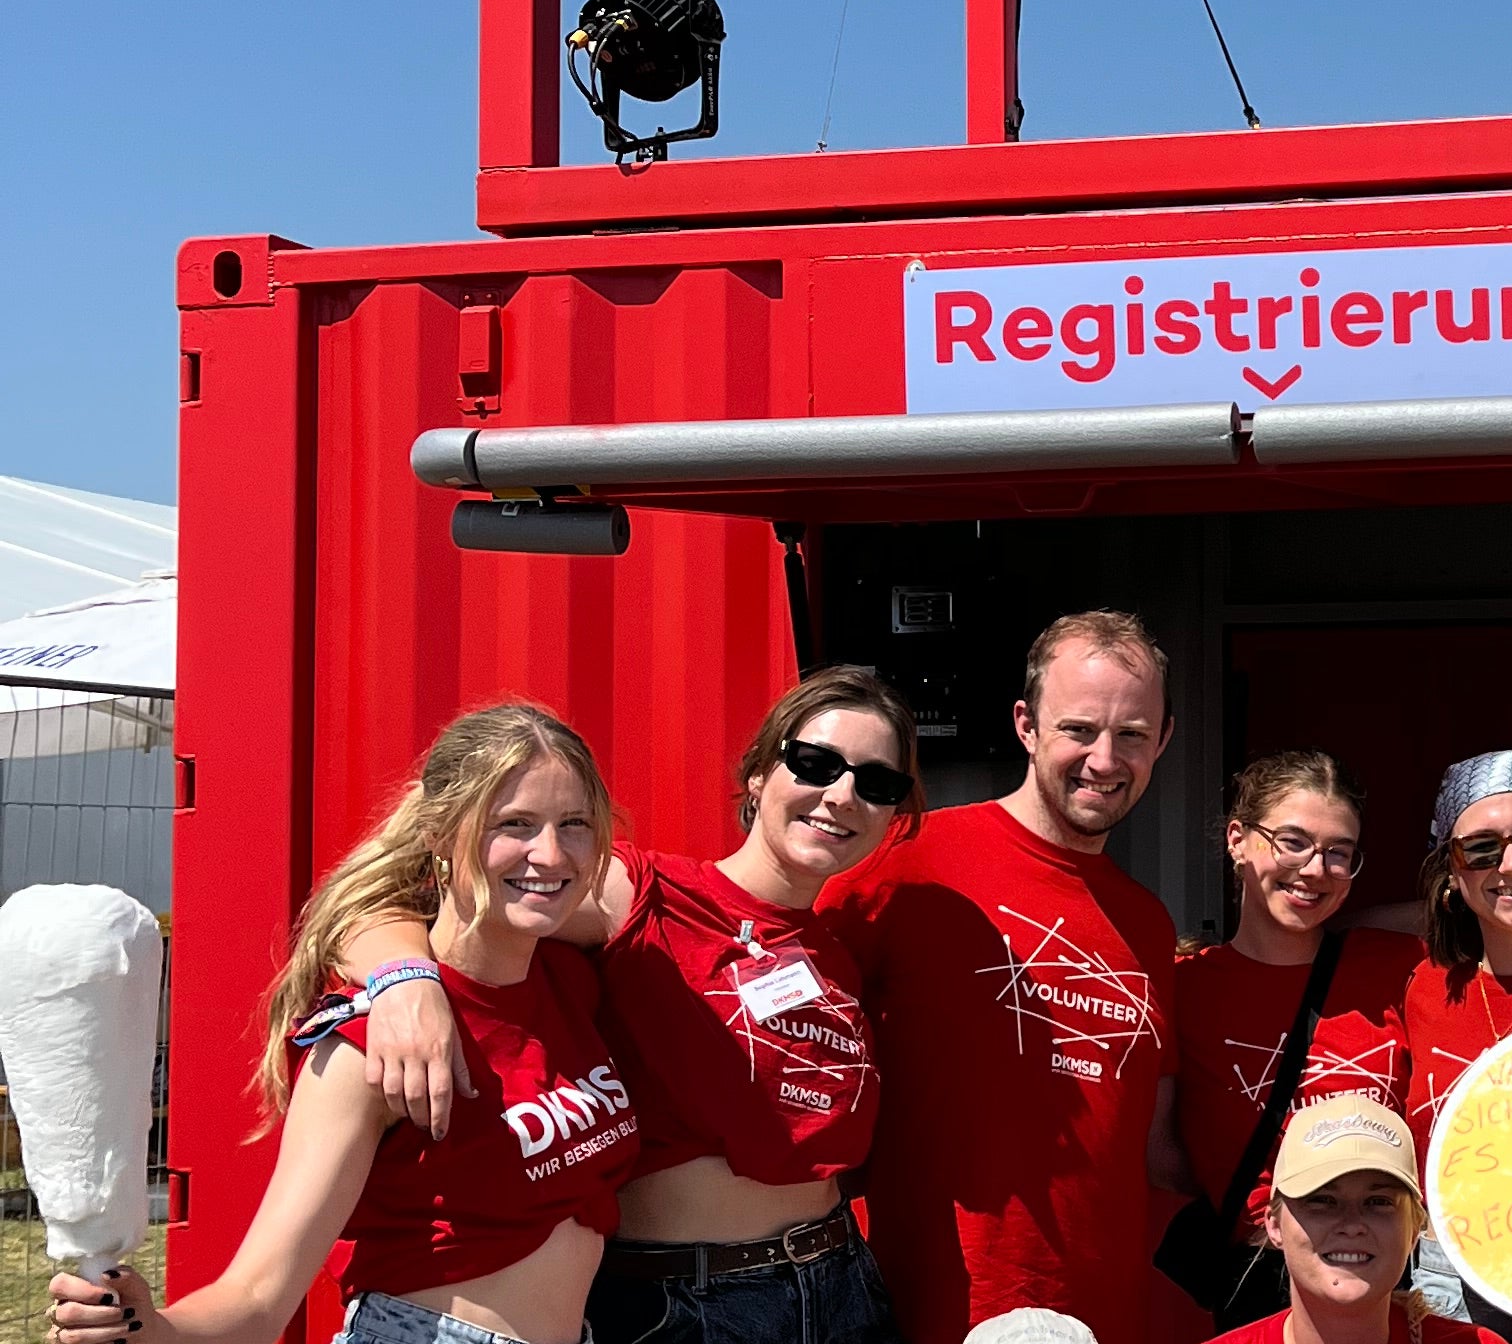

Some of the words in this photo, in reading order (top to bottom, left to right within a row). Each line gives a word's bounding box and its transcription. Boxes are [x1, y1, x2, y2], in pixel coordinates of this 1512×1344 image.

[0, 644, 98, 668] EINER
[1022, 980, 1138, 1024] VOLUNTEER
[757, 1014, 861, 1056] OLUNTEER
[1051, 1053, 1090, 1075] DKMS
[500, 1065, 630, 1159] DKMS
[780, 1082, 819, 1108] DKMS
[526, 1157, 561, 1181] WIR
[564, 1127, 621, 1166] BESIEGEN
